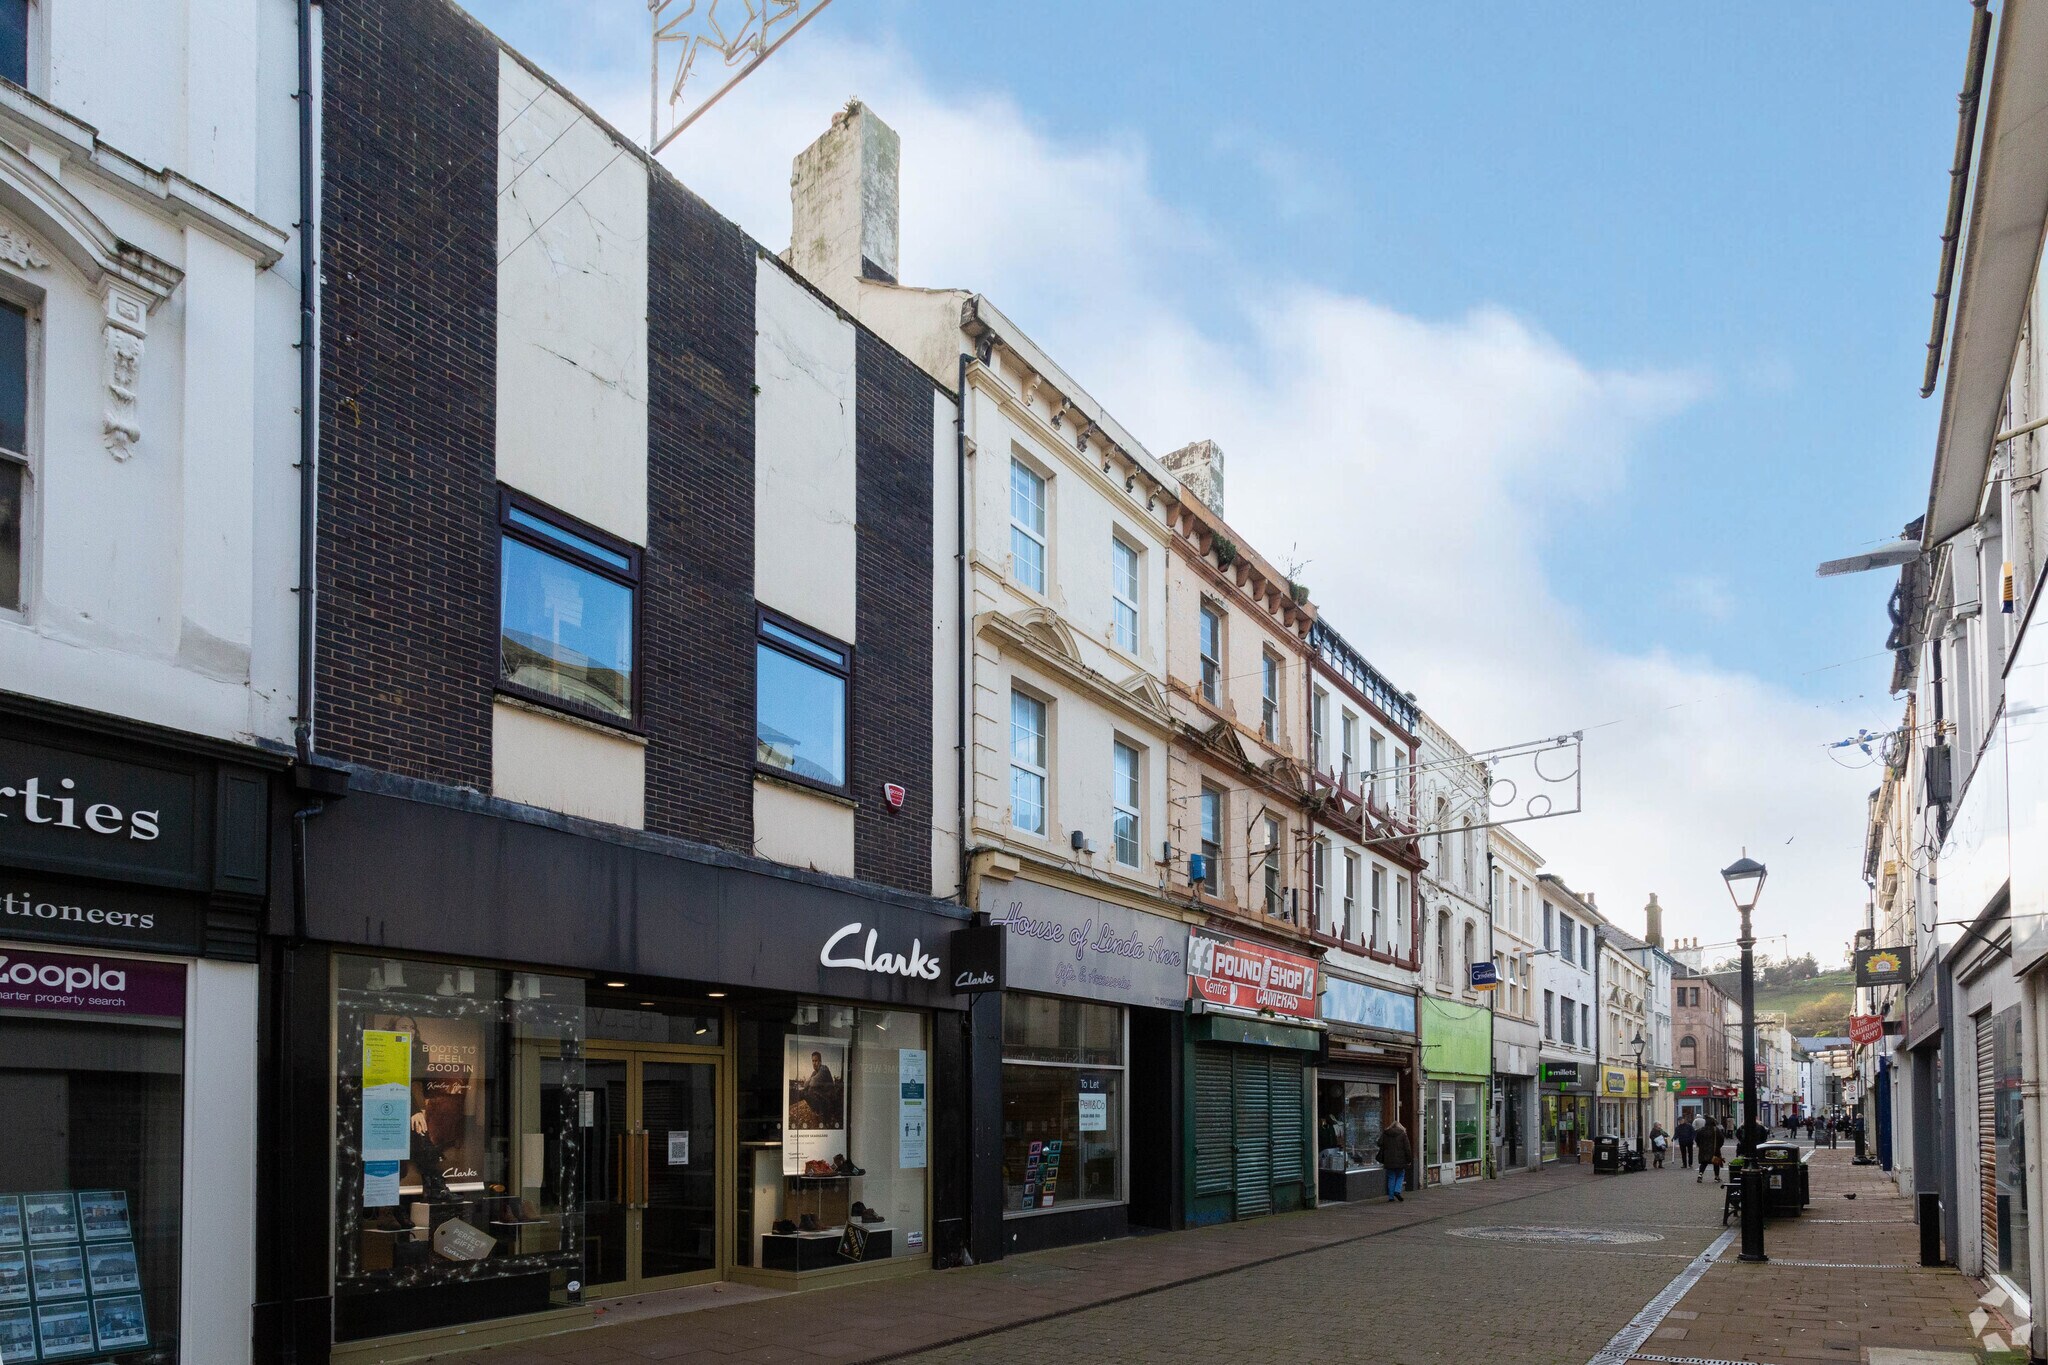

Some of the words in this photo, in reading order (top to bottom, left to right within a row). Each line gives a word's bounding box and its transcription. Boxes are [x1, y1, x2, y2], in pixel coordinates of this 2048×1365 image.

[0, 892, 154, 929] tioneers
[990, 901, 1064, 943] House
[1068, 919, 1092, 960] of
[1091, 922, 1144, 960] Linda
[1148, 936, 1181, 966] Ann
[820, 922, 941, 980] Clarks
[955, 971, 995, 987] Clarks
[1214, 952, 1262, 982] POUND
[1269, 965, 1303, 990] SHOP
[1204, 979, 1228, 996] Centre
[35, 994, 85, 1006] property
[88, 996, 126, 1006] search
[1256, 989, 1299, 1010] CAMERAS
[1851, 1020, 1880, 1038] SALVATION
[1856, 1018, 1868, 1027] THE
[1862, 1029, 1879, 1042] ARMY
[422, 1044, 459, 1054] BOOTS
[462, 1045, 476, 1055] TO
[438, 1054, 464, 1063] FEEL
[427, 1063, 460, 1072] GOOD
[463, 1064, 474, 1073] IN
[1080, 1079, 1088, 1089] To
[1089, 1079, 1099, 1089] Let
[442, 1166, 478, 1178] Clarks
[454, 1237, 475, 1253] GIFTS
